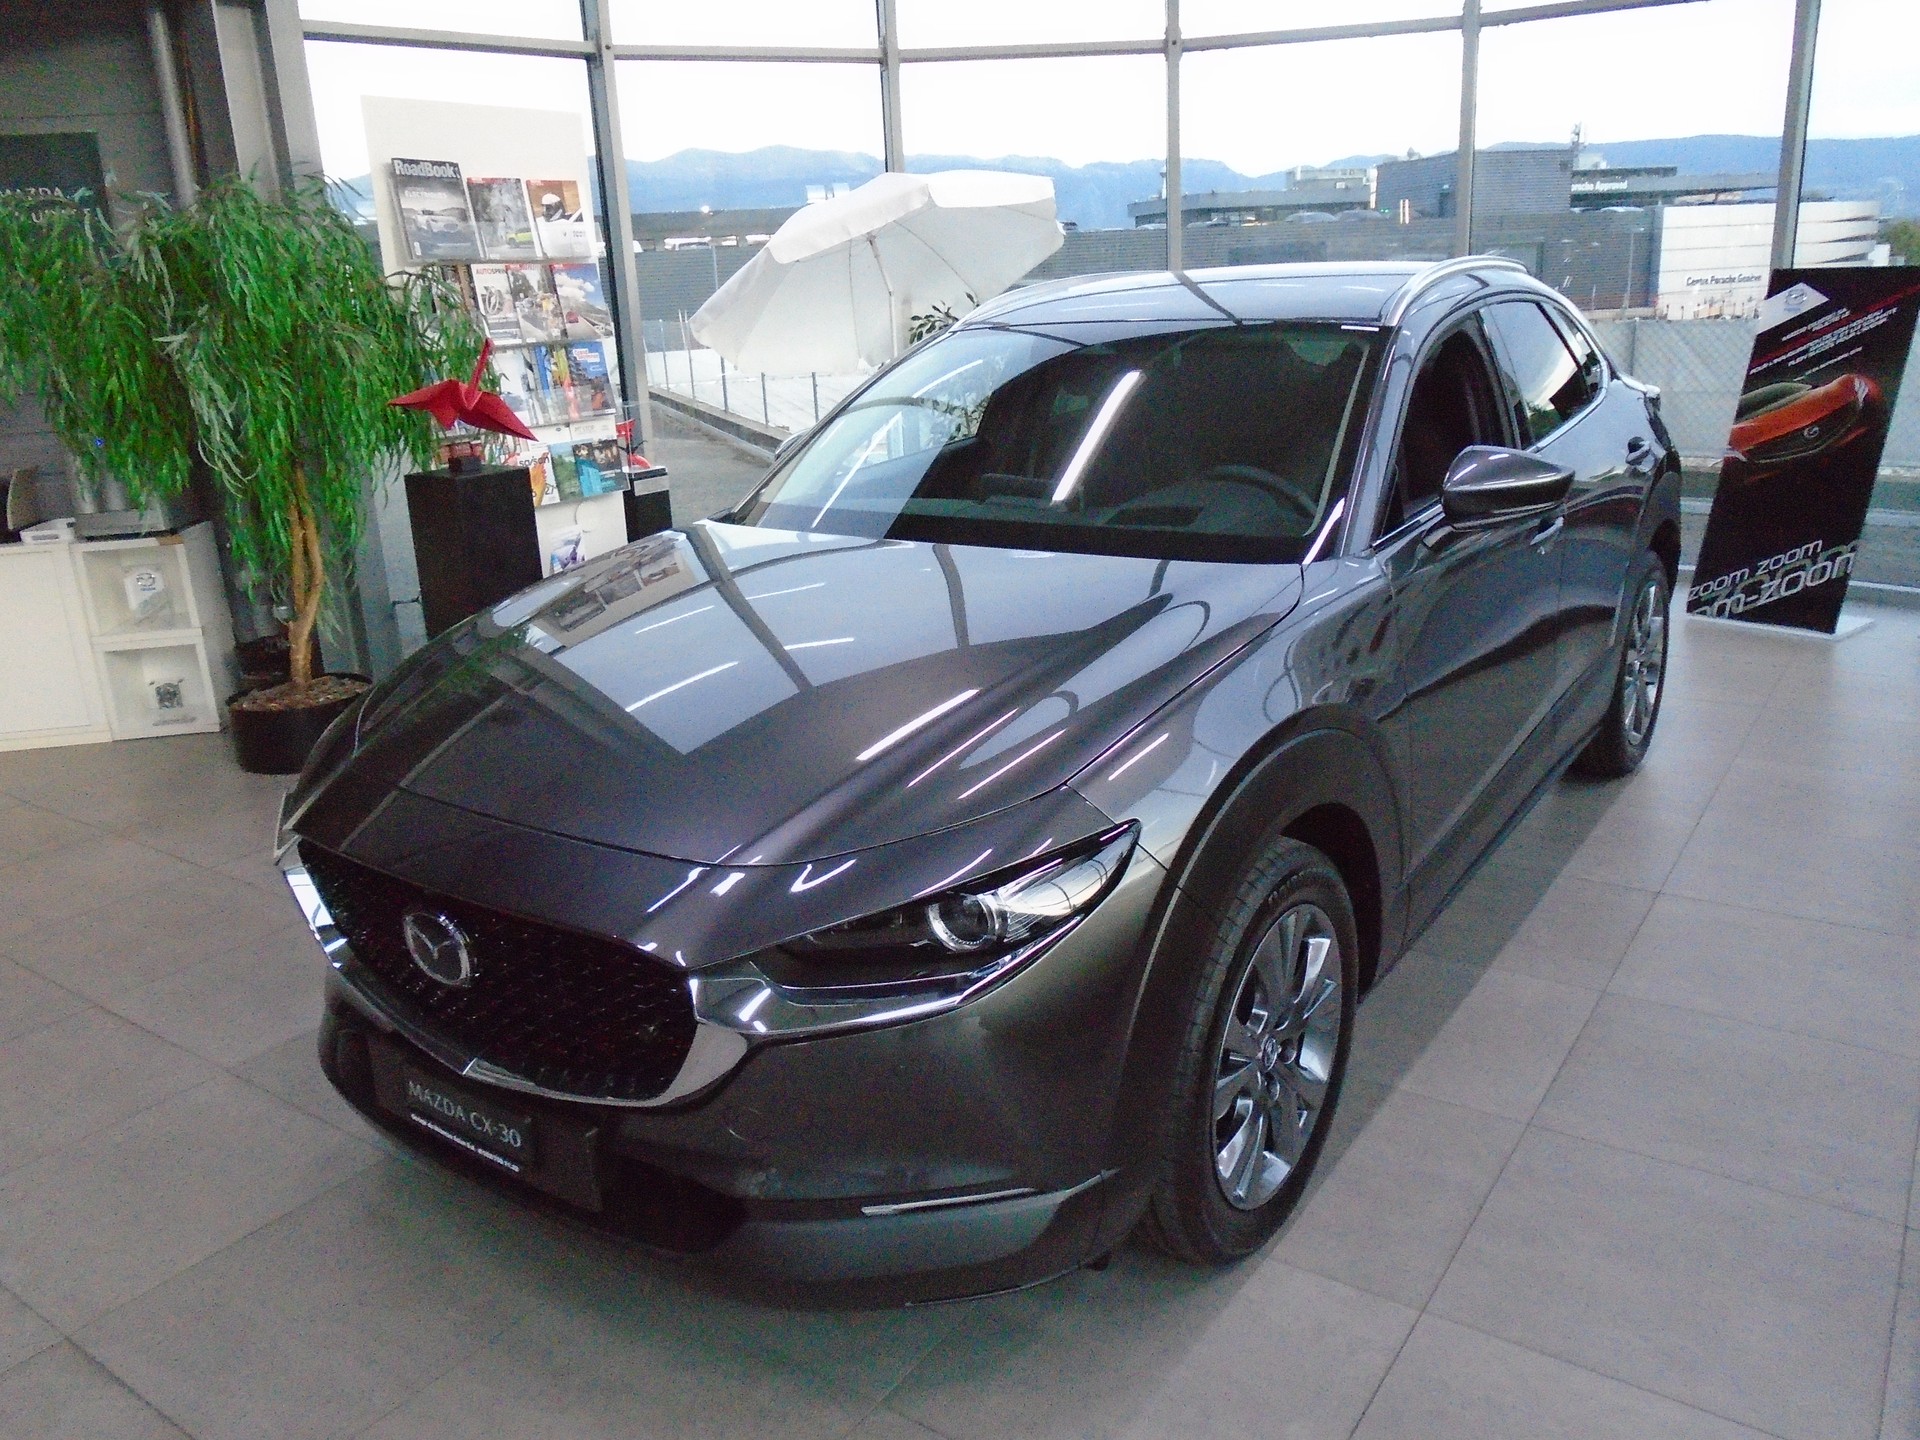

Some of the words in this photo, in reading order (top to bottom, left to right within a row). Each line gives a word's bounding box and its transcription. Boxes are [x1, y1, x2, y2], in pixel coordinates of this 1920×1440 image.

[394, 160, 457, 178] RoadBook
[1689, 568, 1750, 601] zoom
[1756, 540, 1823, 576] zoom
[408, 1081, 466, 1122] MAZDA
[470, 1112, 521, 1148] CX-30
